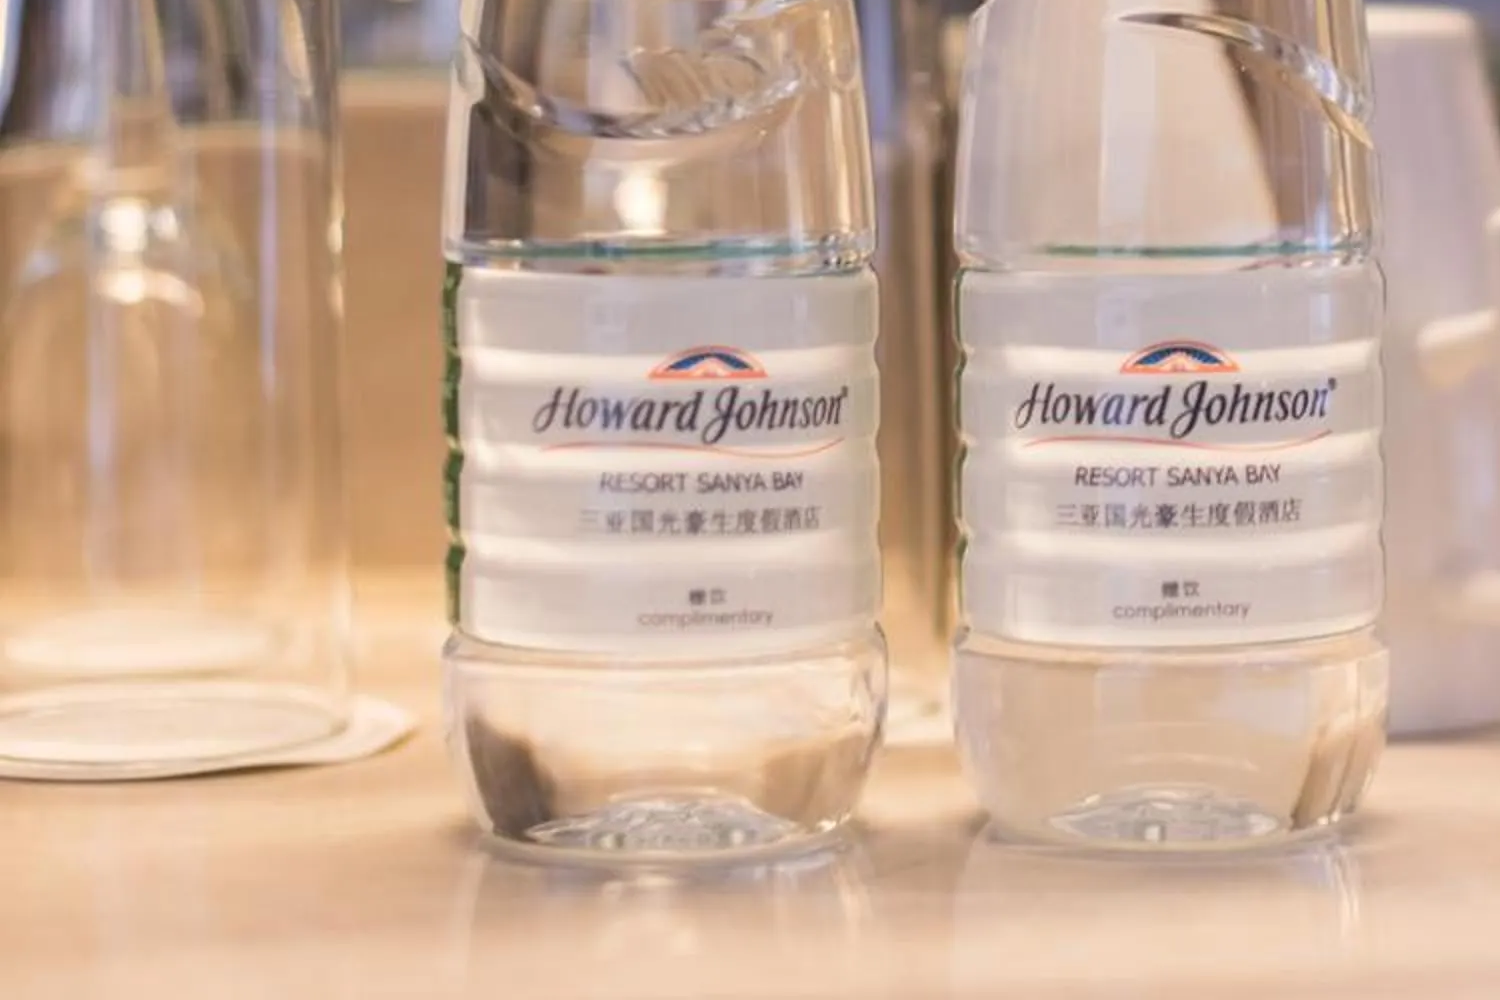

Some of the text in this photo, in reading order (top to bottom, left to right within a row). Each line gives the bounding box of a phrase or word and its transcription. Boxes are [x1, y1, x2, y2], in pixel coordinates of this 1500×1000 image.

[533, 385, 842, 445] Howard Johnson
[1014, 379, 1330, 440] Howard Johnson
[600, 470, 804, 494] RESORT SANYA BAY
[1074, 464, 1282, 487] RESORT SANYA BAY
[1055, 498, 1303, 529] 三亚国光豪生度假酒店
[637, 608, 774, 628] complimentary
[1112, 601, 1251, 621] complimentary
